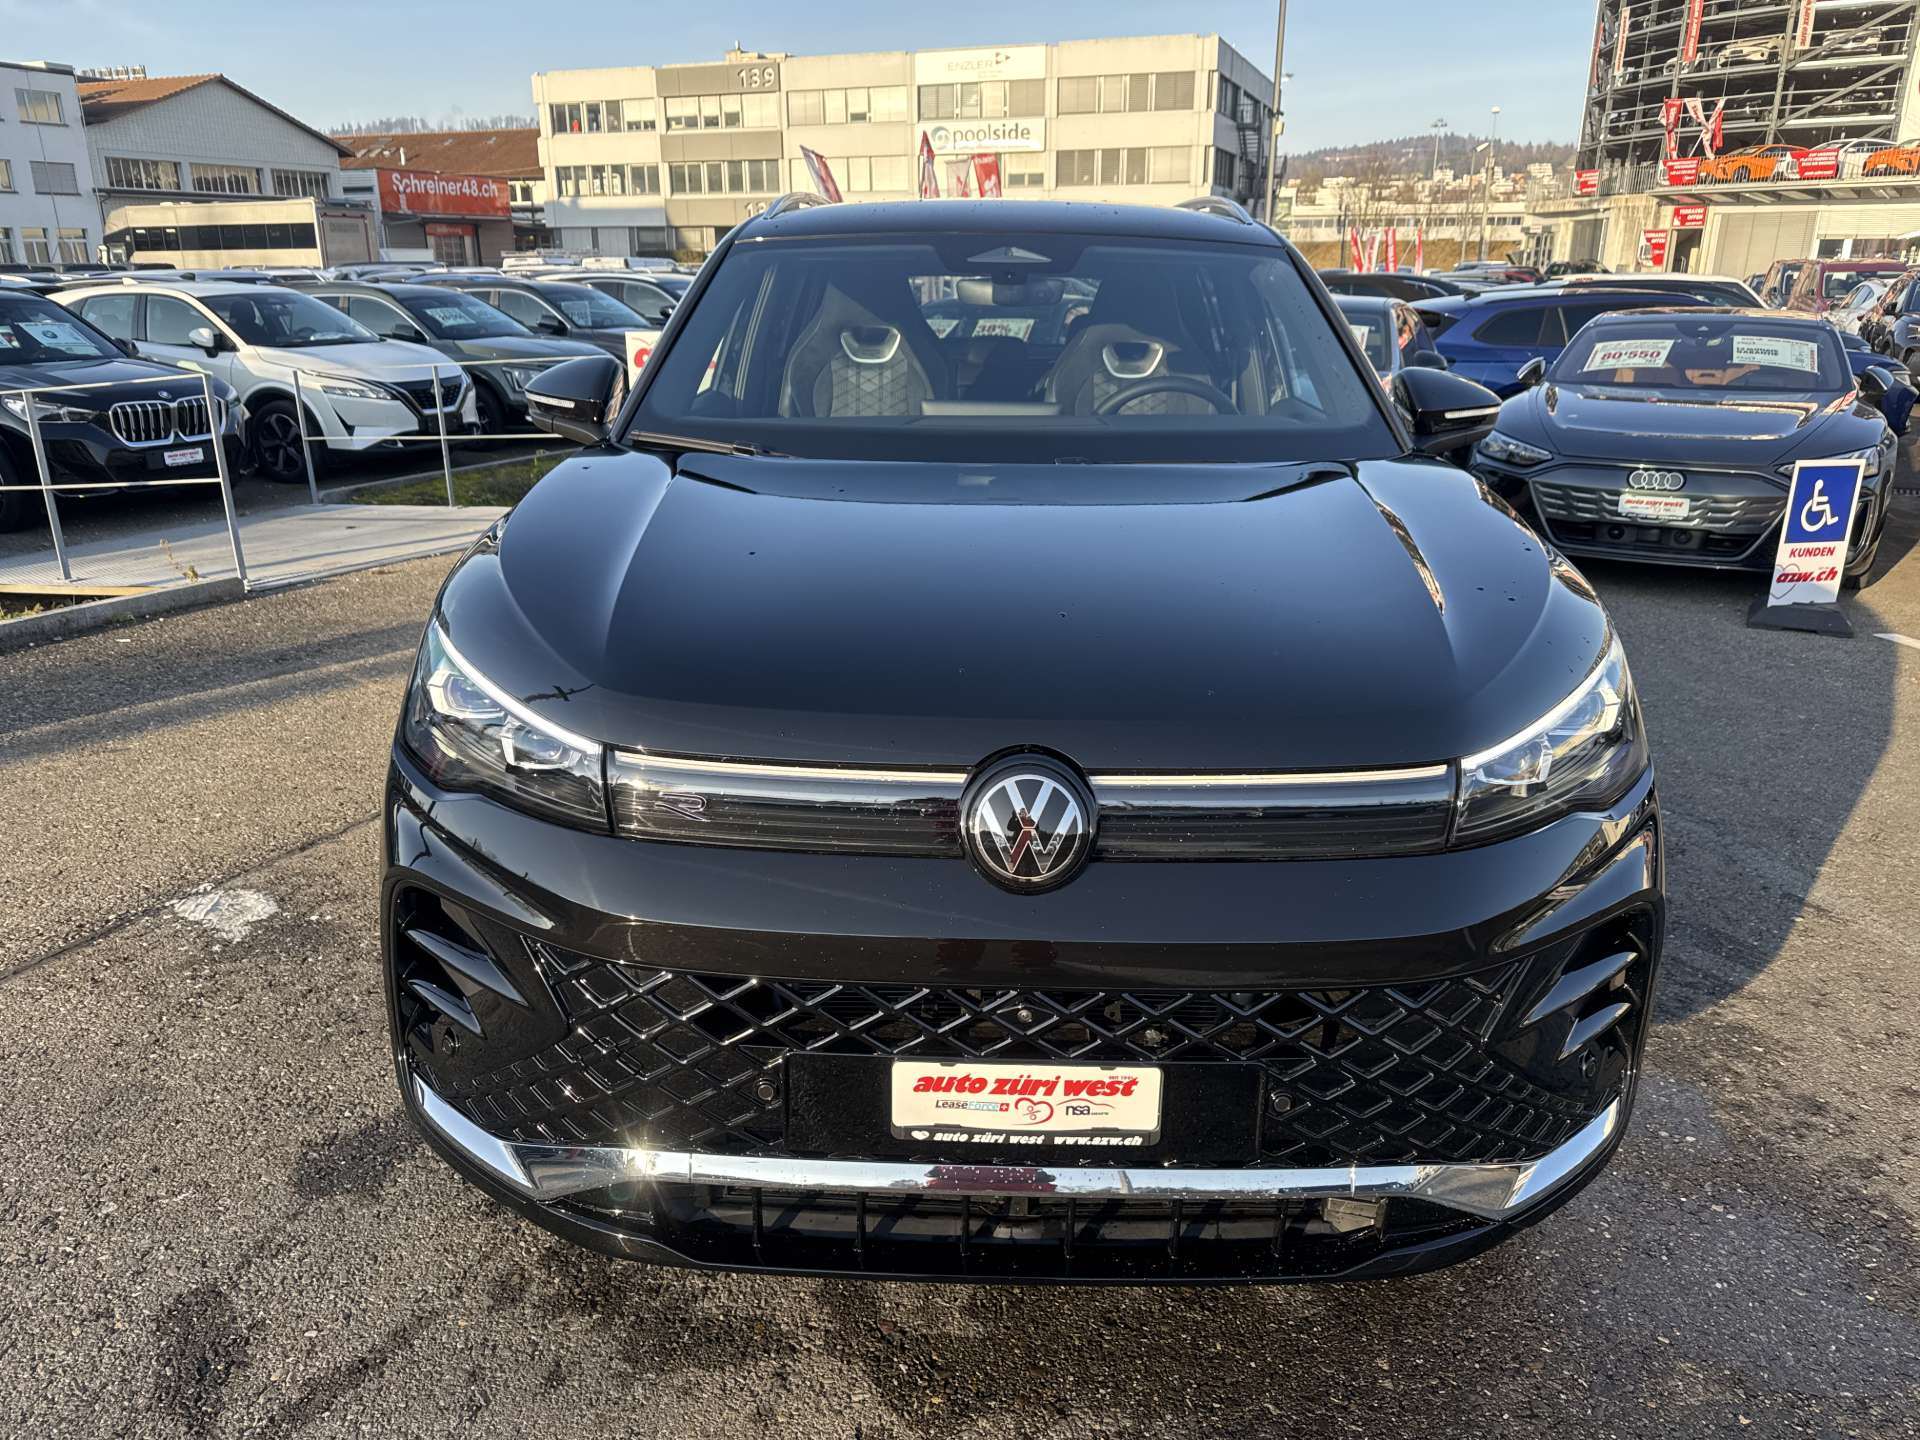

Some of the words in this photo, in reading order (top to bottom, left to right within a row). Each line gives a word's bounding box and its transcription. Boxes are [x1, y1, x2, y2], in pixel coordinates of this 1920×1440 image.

[737, 66, 775, 88] 139
[953, 122, 1031, 150] poolside
[391, 173, 498, 197] Schreiner48.ch
[1789, 546, 1836, 558] KUNDEN
[1776, 566, 1838, 583] azw.ch
[912, 1074, 988, 1094] auto
[988, 1074, 1061, 1096] züri
[1063, 1077, 1139, 1097] west
[935, 1099, 999, 1112] LeaseForce
[1065, 1105, 1091, 1116] nsa
[933, 1132, 969, 1142] auto
[971, 1132, 1006, 1143] züri
[1009, 1134, 1045, 1145] west
[1053, 1135, 1143, 1146] www.azw.ch
